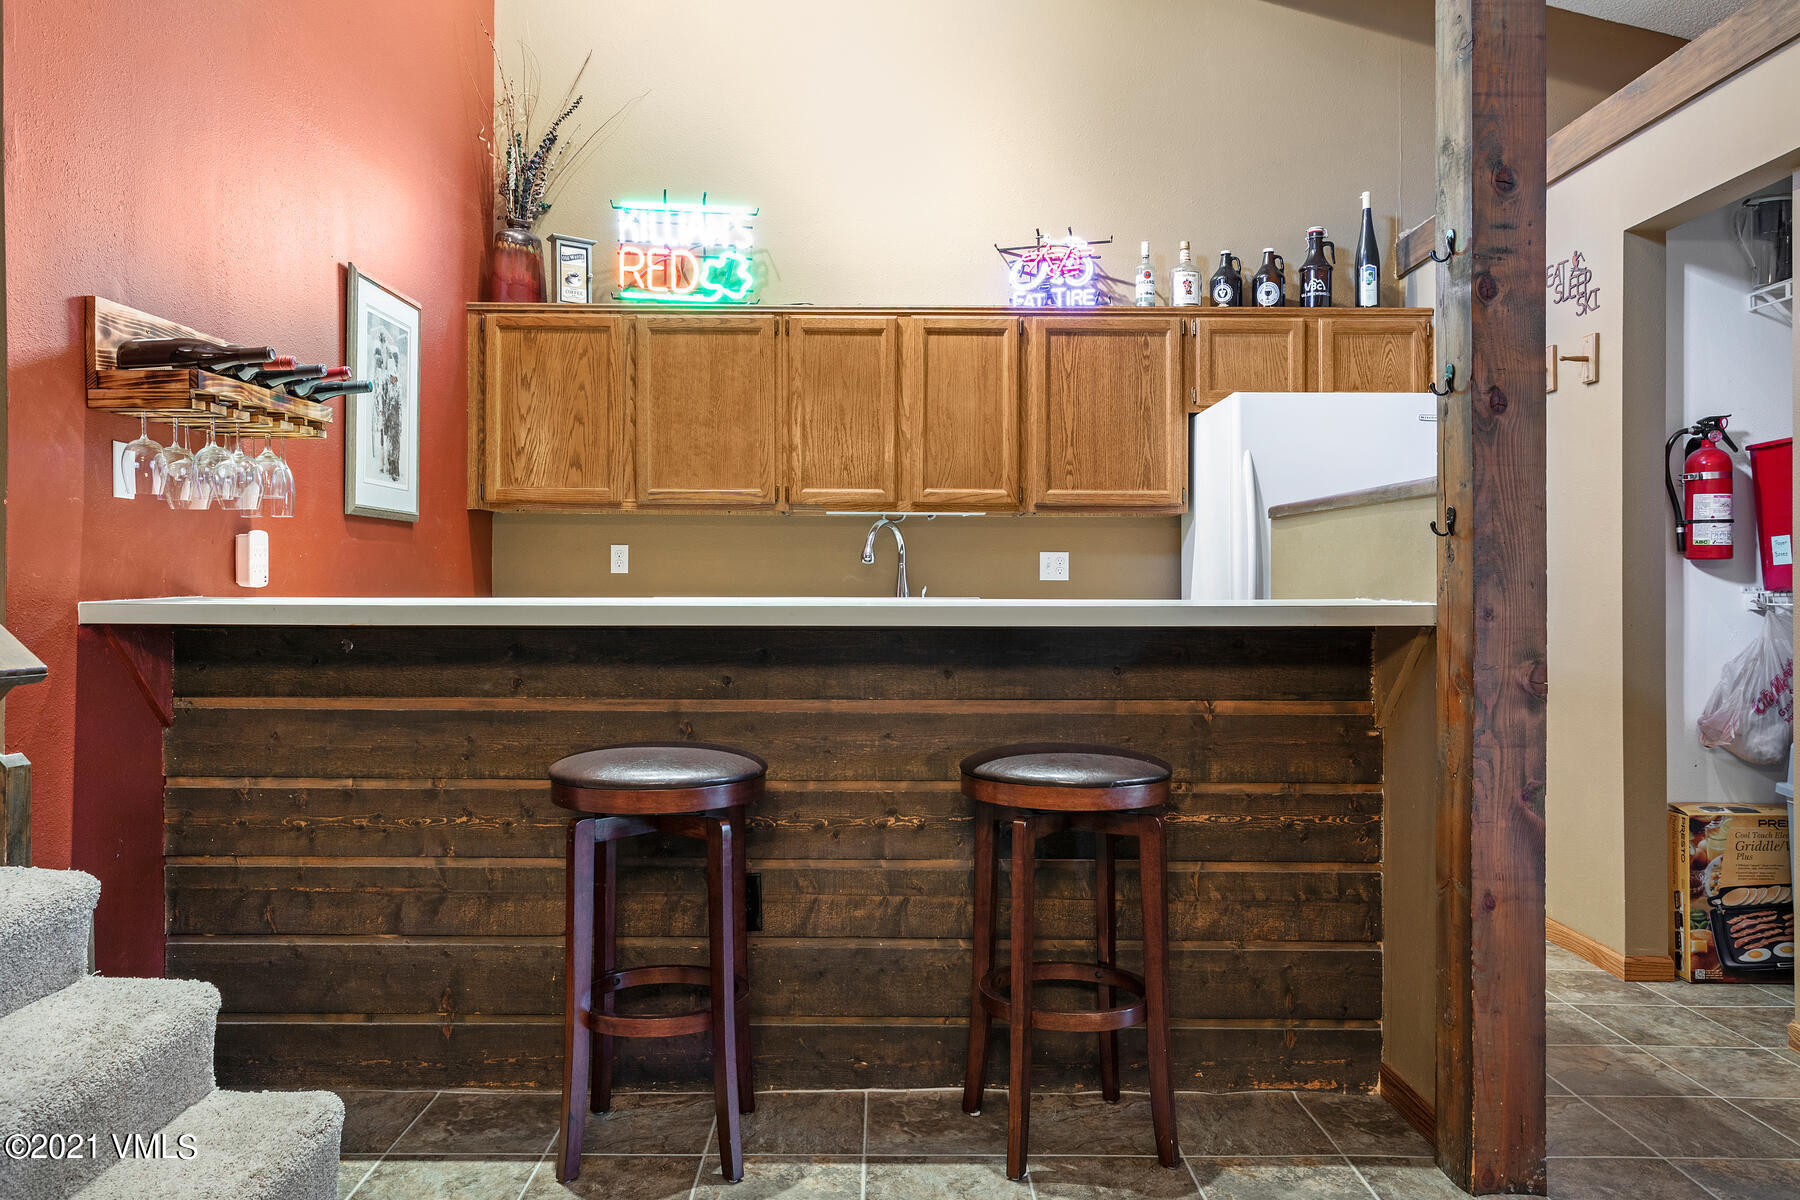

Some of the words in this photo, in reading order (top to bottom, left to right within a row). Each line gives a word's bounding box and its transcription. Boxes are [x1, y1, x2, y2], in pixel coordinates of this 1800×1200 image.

[618, 246, 700, 293] RED
[1546, 259, 1569, 289] EAT
[1012, 290, 1047, 307] FAT
[1051, 287, 1096, 307] TIRE
[1553, 268, 1593, 305] SLEEP
[1576, 287, 1601, 317] SKI
[1735, 831, 1750, 839] Cool
[1752, 831, 1773, 839] Touch
[1758, 819, 1789, 830] PRE
[1736, 852, 1753, 860] Plus
